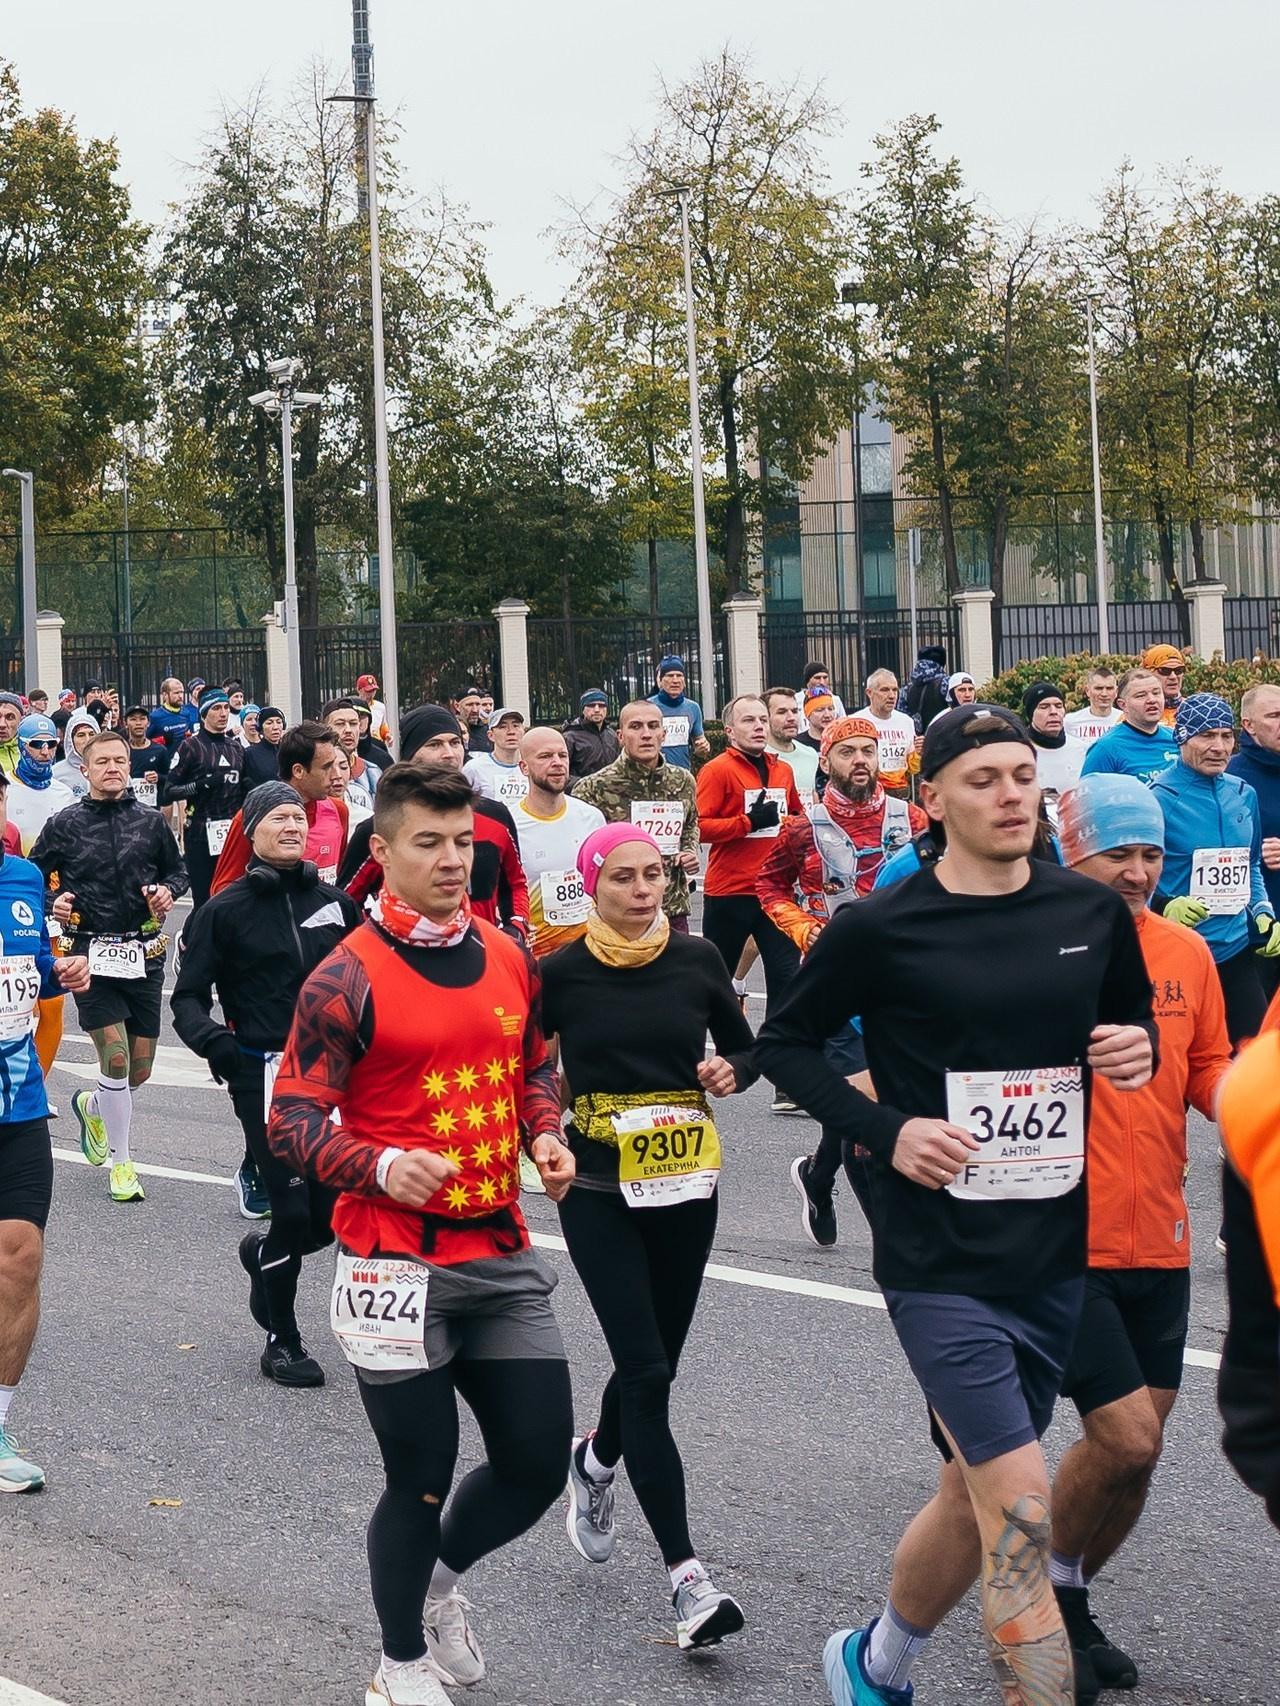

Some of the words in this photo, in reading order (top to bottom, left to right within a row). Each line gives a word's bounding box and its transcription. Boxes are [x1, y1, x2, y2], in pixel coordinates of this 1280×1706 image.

[882, 747, 905, 758] 3162
[500, 783, 527, 795] 6792
[635, 820, 682, 837] 17262
[1195, 865, 1248, 886] 13857
[549, 910, 558, 920] G
[92, 963, 101, 971] G
[0, 1005, 19, 1015] ИЛЬЯ
[970, 1101, 1067, 1143] 3462
[632, 1126, 705, 1164] 9307
[1000, 1145, 1041, 1157] АНТОН
[643, 1160, 701, 1176] ЕКАТЕРИНА
[964, 1165, 980, 1185] F
[630, 1182, 645, 1197] B
[335, 1284, 420, 1324] 11224
[359, 1323, 382, 1335] ИВАН
